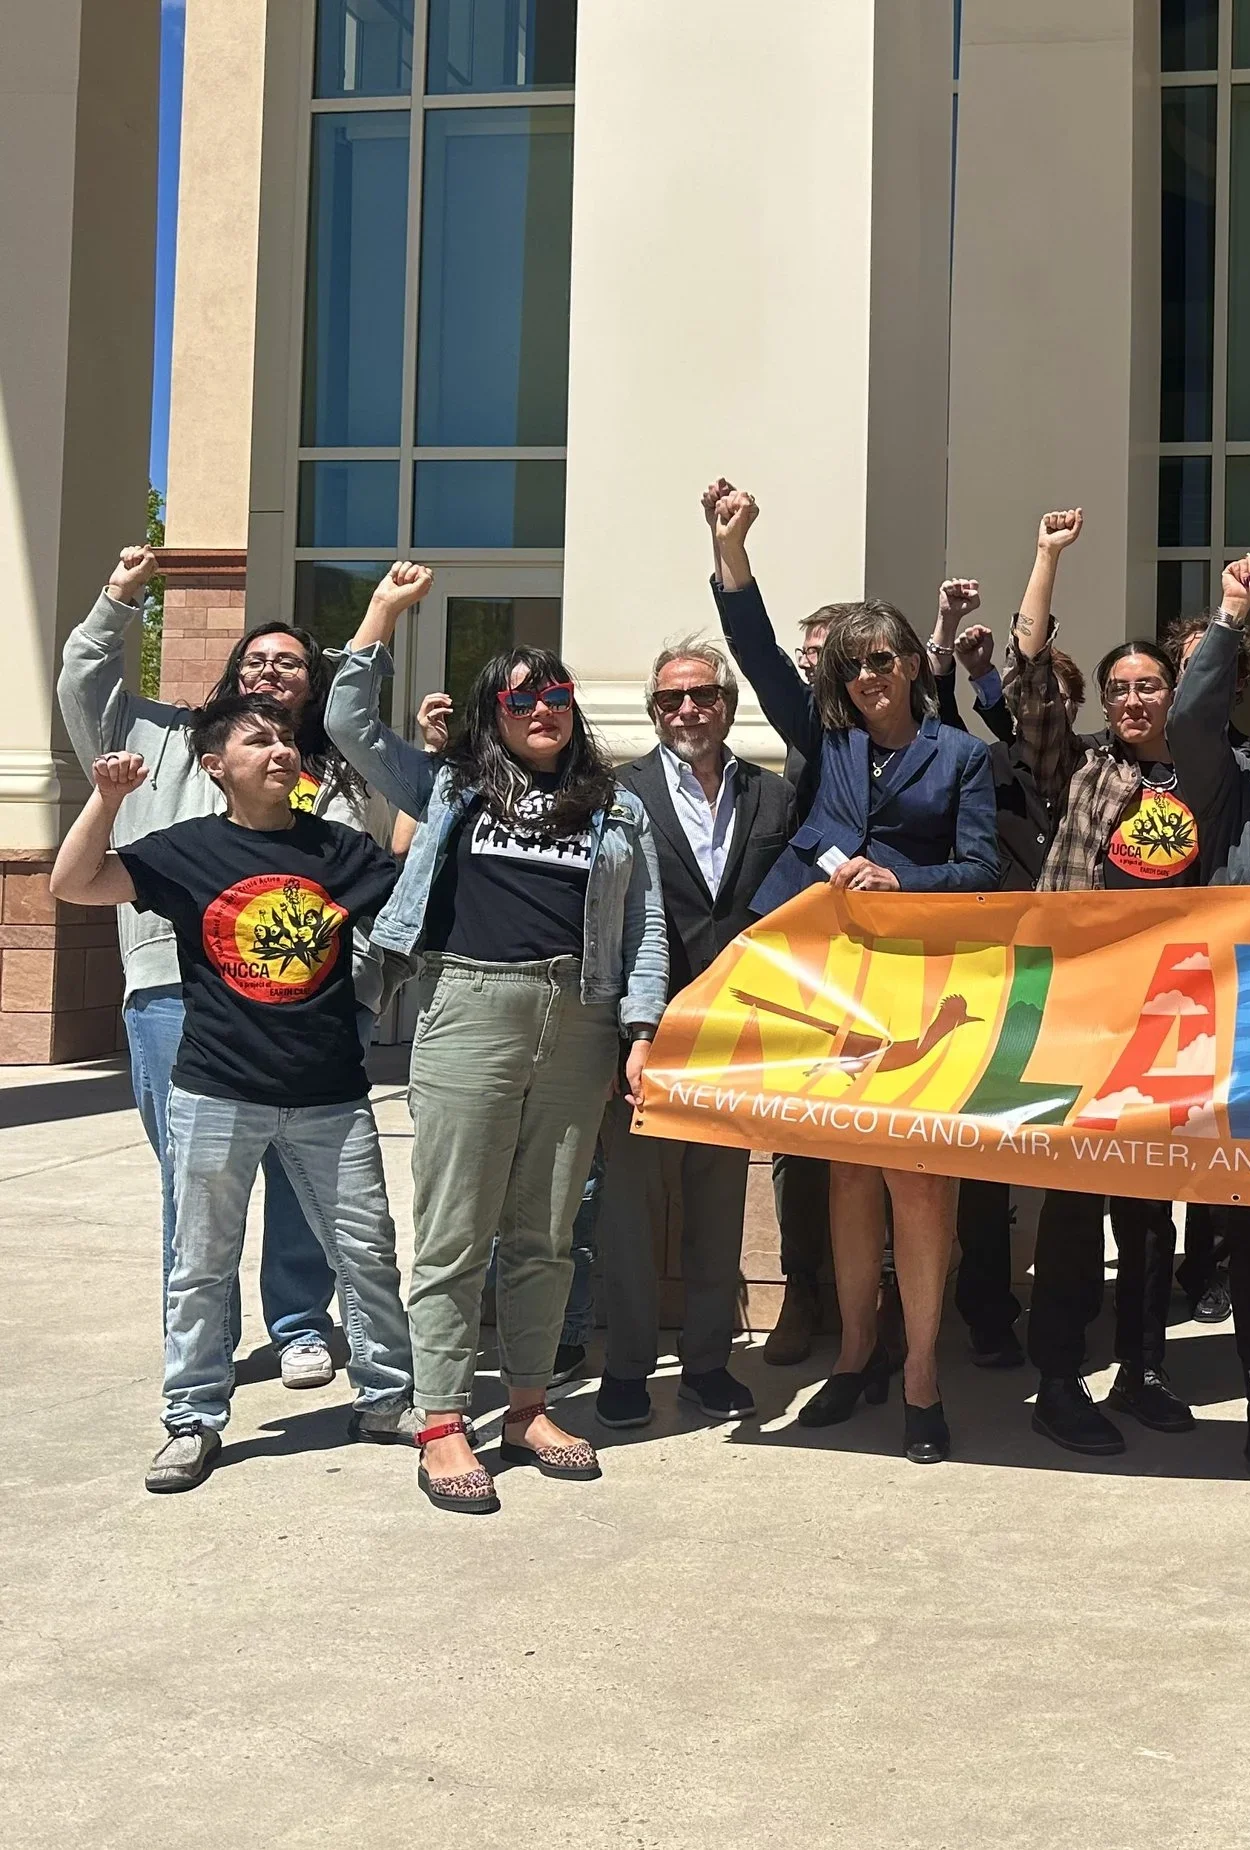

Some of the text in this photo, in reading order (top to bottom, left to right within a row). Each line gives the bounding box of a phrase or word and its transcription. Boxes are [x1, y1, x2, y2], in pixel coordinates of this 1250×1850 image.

[1110, 843, 1142, 858] UCCA
[220, 962, 270, 978] YUCCA
[669, 1081, 747, 1113] NEW
[751, 1093, 878, 1133] MEXICO
[888, 1111, 985, 1152] LAND,
[996, 1123, 1060, 1161] AIR,
[1070, 1135, 1197, 1172] WATER,
